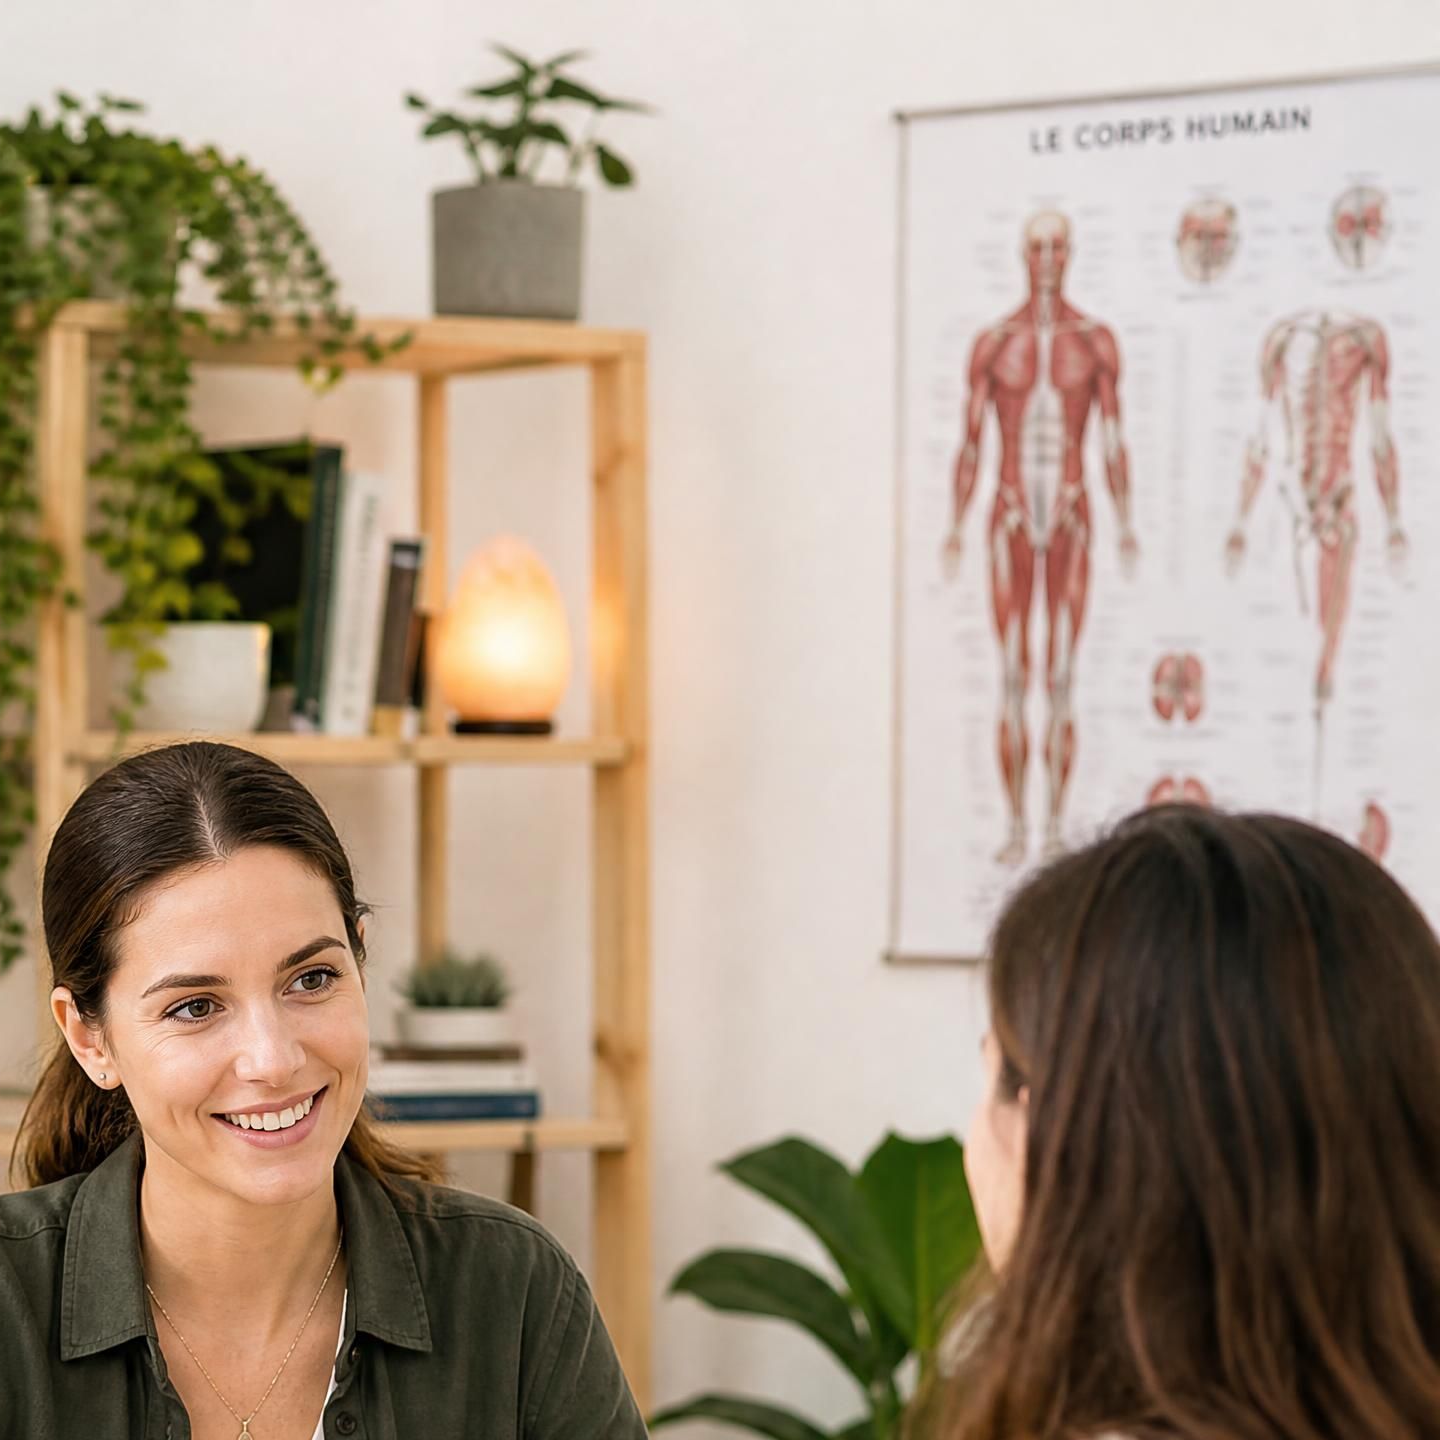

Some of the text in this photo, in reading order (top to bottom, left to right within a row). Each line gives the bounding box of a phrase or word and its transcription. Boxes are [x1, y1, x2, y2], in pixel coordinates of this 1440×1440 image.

[1031, 107, 1312, 154] LE CORPS HUMAIN
